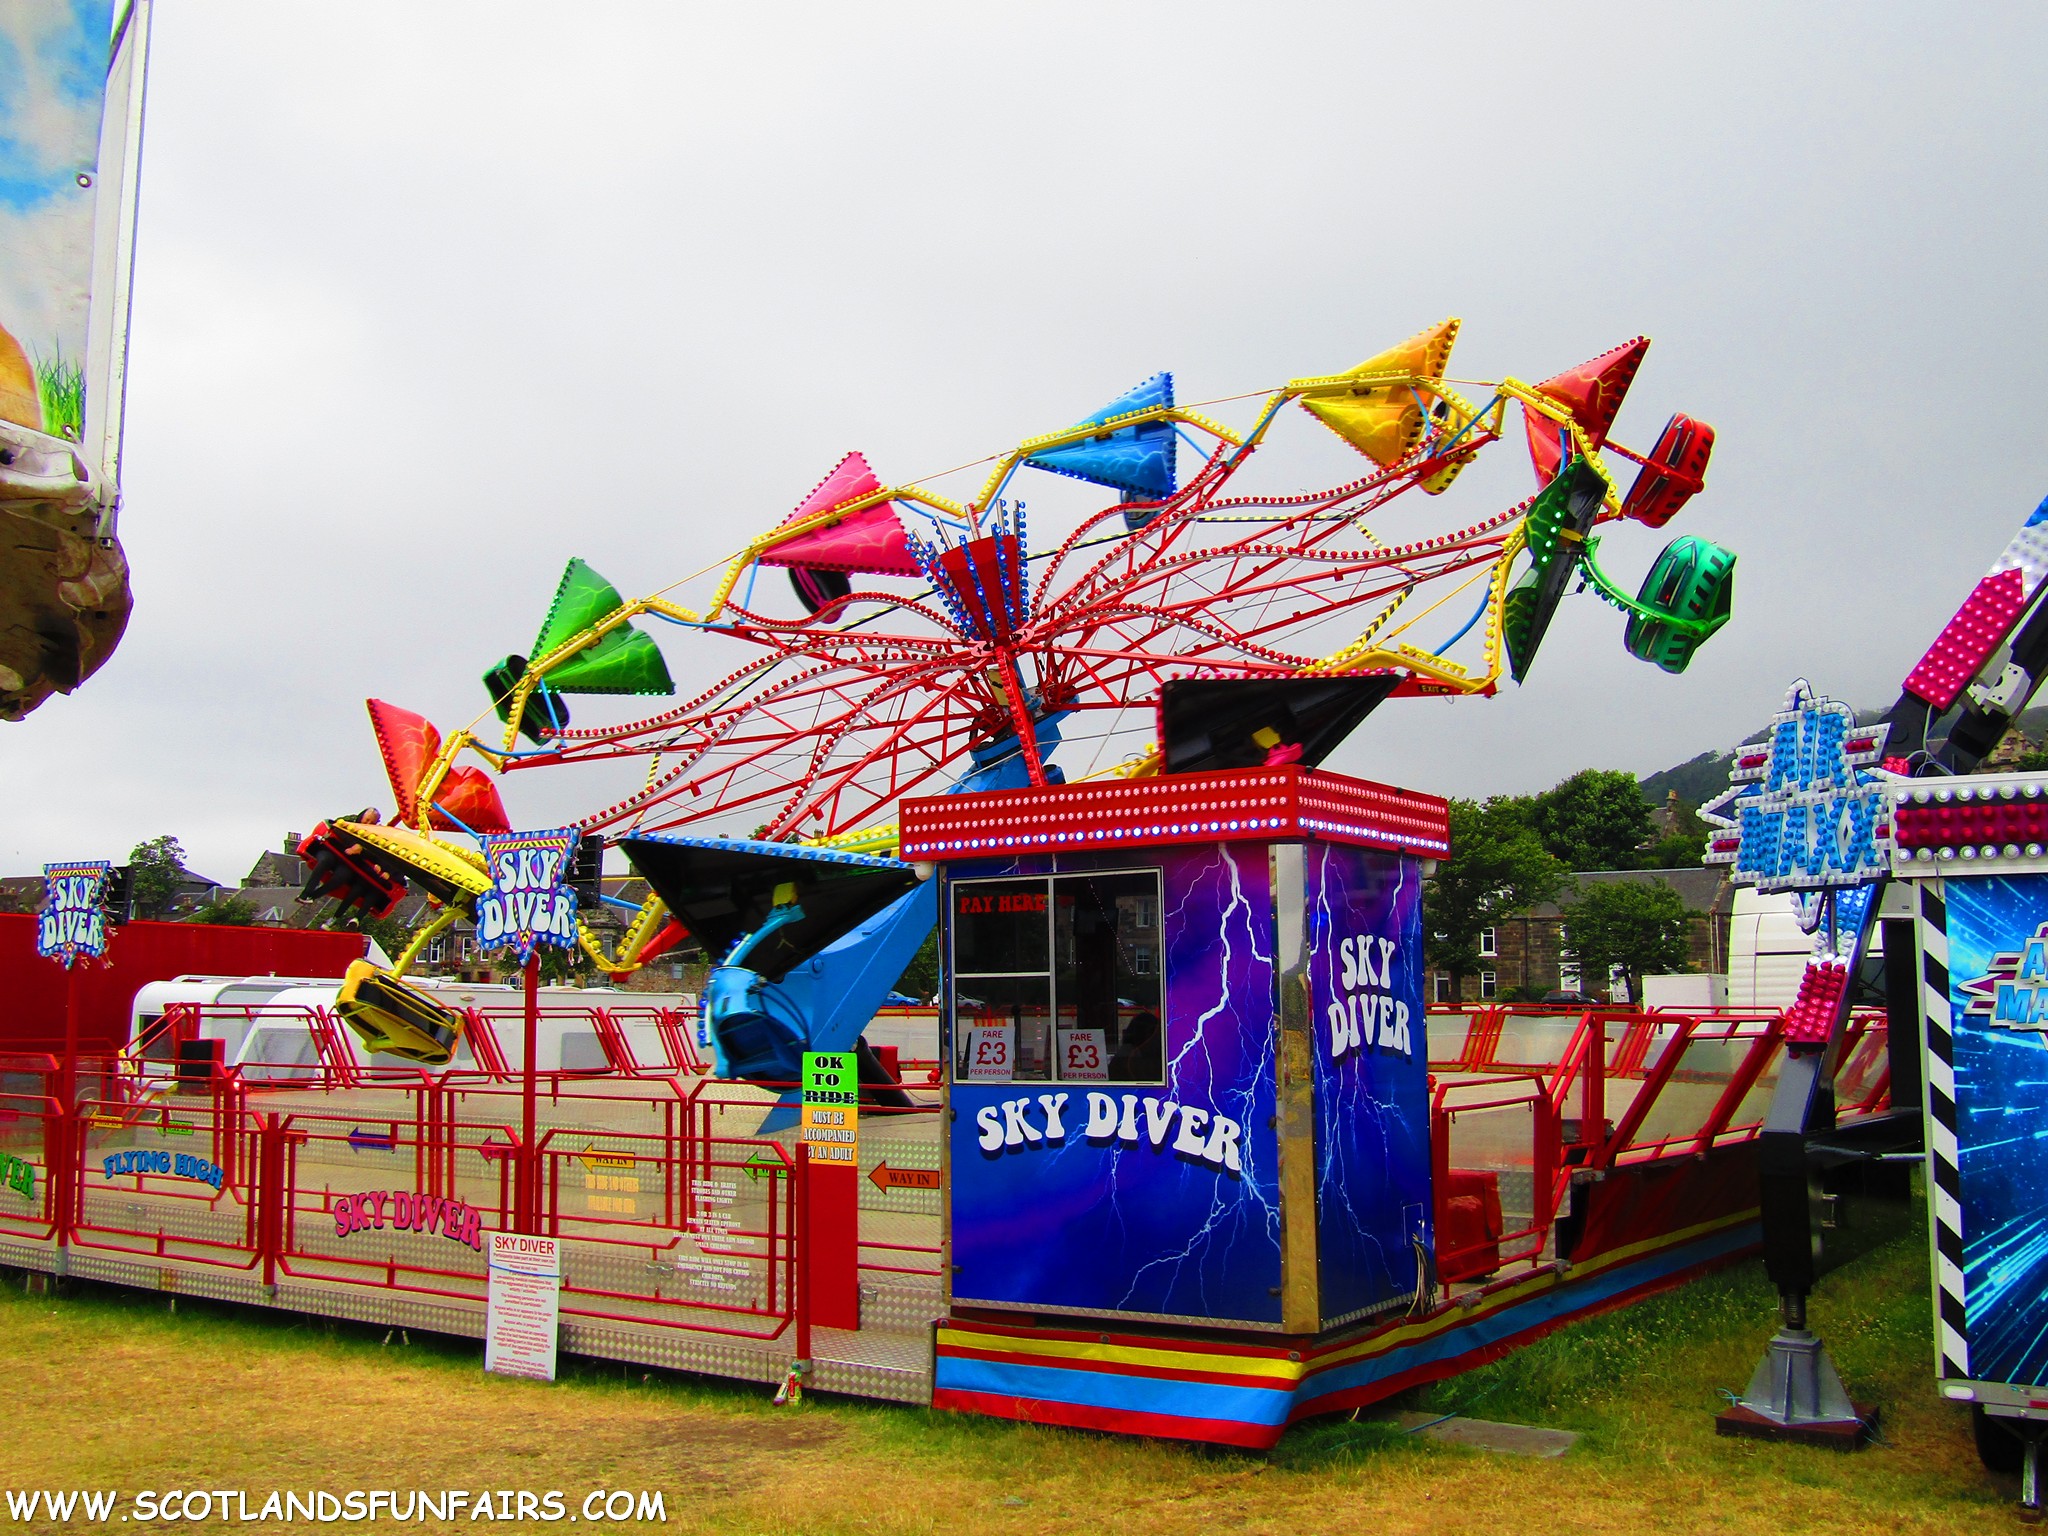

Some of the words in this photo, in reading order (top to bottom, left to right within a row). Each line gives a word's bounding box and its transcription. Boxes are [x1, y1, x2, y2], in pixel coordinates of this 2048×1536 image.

[1769, 709, 1847, 792] AIR
[1741, 793, 1881, 877] MAXX
[499, 848, 559, 893] SKY
[55, 876, 95, 911] SKY
[959, 895, 994, 914] PAY
[998, 893, 1046, 913] HERE
[483, 892, 571, 940] DIVER
[42, 911, 100, 949] DIVER
[1340, 934, 1396, 991] SKY
[2021, 942, 2048, 980] A
[982, 1030, 1003, 1038] FARE
[1070, 1033, 1092, 1041] FARE
[1327, 993, 1412, 1057] DIVER
[814, 1056, 844, 1069] OK
[976, 1041, 1007, 1065] £3
[1068, 1044, 1100, 1069] £3
[812, 1073, 840, 1086] TO
[984, 1068, 1011, 1076] PERSON
[805, 1090, 855, 1104] RIDE
[812, 1110, 831, 1124] MUST
[833, 1111, 844, 1125] BE
[803, 1127, 856, 1143] ACCOMPANIED
[976, 1092, 1069, 1152] SKY
[1085, 1092, 1242, 1171] DIVER
[817, 1146, 828, 1159] AN
[830, 1147, 853, 1161] ADULT
[102, 1150, 172, 1180] FLYING
[173, 1152, 225, 1190] HIGH
[889, 1172, 915, 1184] WAY
[917, 1173, 930, 1185] IN
[334, 1190, 388, 1238] SKY
[392, 1190, 482, 1252] DIVER
[495, 1236, 517, 1250] SKY
[520, 1238, 555, 1254] DIVER
